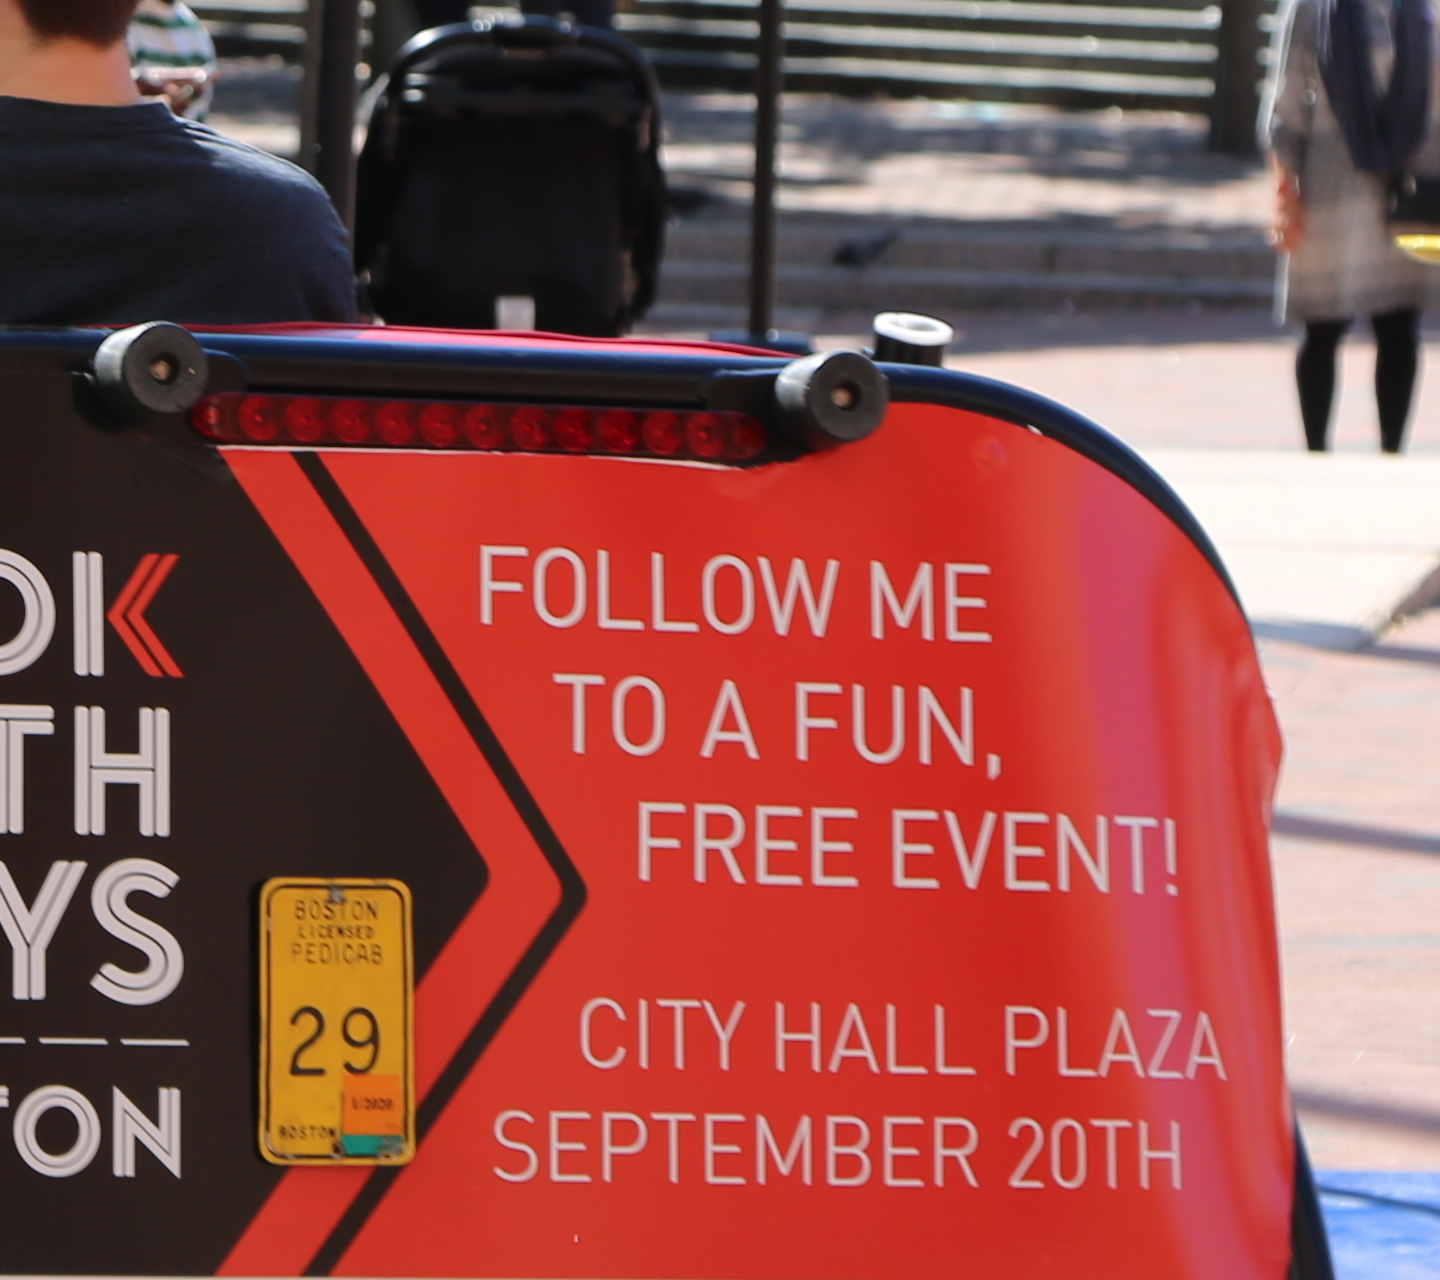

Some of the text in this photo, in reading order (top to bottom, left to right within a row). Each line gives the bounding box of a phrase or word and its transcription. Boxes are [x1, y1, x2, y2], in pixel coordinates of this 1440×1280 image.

[478, 544, 993, 643] FOLLOW ME
[552, 673, 1002, 781] TO A FUN,
[637, 801, 1179, 898] FREE EVENT!
[294, 899, 378, 921] BOSTON
[291, 942, 383, 965] PEDICAB
[289, 1006, 381, 1076] 29
[578, 996, 1228, 1082] CITY HALL PLAZA
[492, 1109, 1183, 1191] SEPTEMBER 20TH
